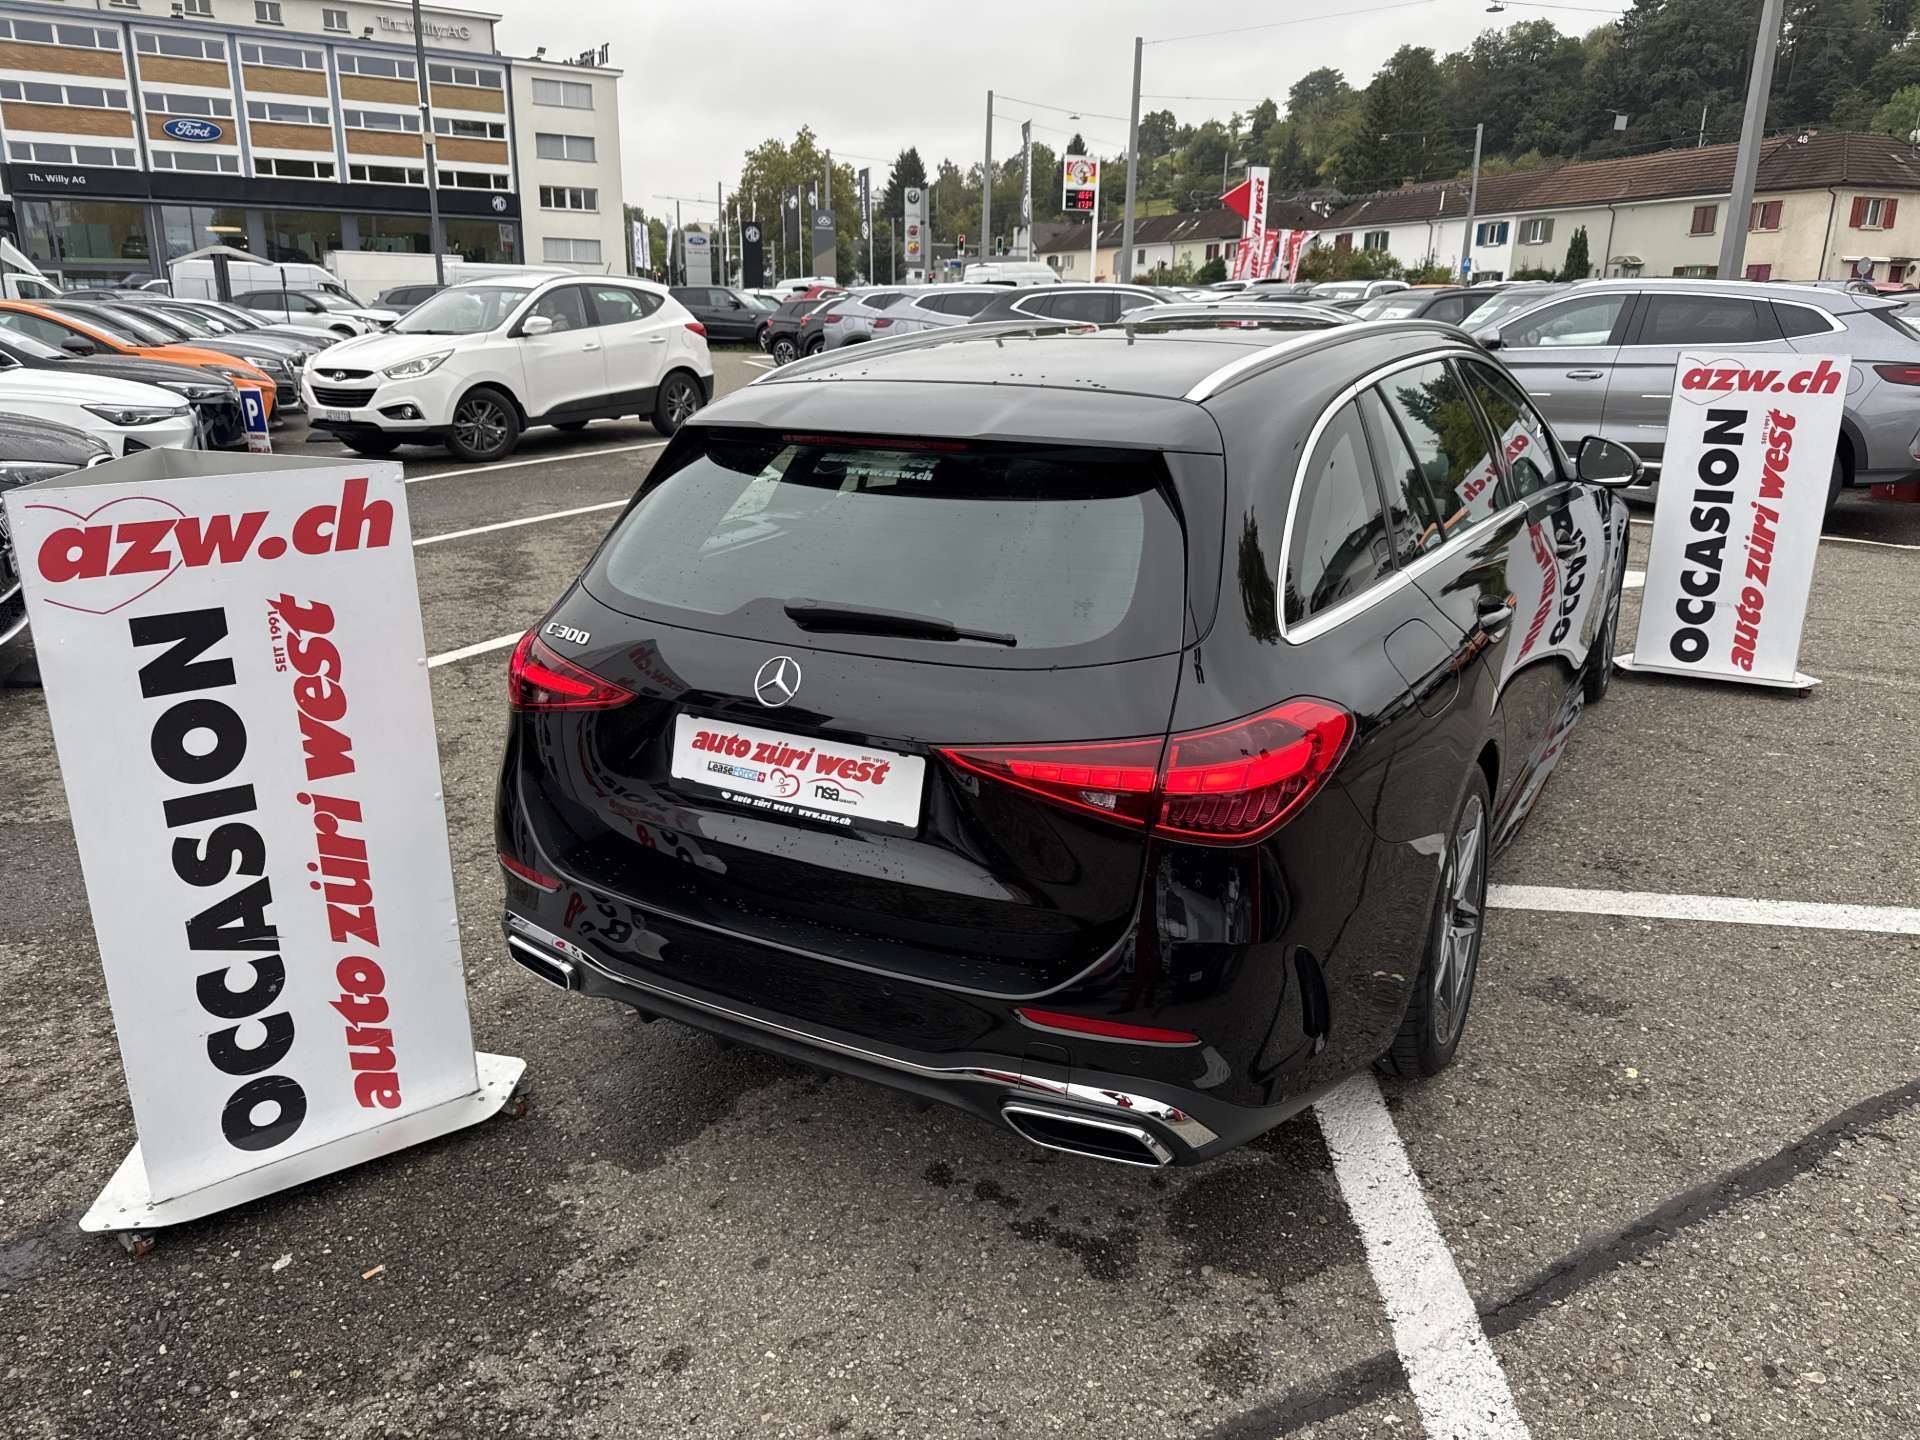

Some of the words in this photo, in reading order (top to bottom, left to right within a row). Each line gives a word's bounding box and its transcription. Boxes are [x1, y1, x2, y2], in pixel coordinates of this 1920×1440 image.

[445, 24, 472, 42] AG
[174, 119, 212, 138] Ford
[1797, 135, 1809, 144] 48
[27, 173, 43, 182] Th.
[45, 174, 69, 185] Willy
[71, 176, 86, 185] AG
[1681, 359, 1842, 394] azw.ch
[245, 398, 259, 427] P
[1759, 408, 1797, 499] west
[846, 466, 935, 481] www.azw.ch
[37, 477, 394, 583] azw.ch
[1669, 408, 1748, 663] OCCASION
[1744, 501, 1780, 588] züri
[268, 609, 283, 639] 1991
[1731, 585, 1764, 672] auto
[273, 645, 288, 673] SEIT
[266, 592, 356, 781] west
[691, 730, 752, 759] auto
[751, 740, 816, 774] züri
[815, 754, 891, 785] west
[707, 760, 758, 782] LeaseForce
[732, 794, 752, 804] auto
[753, 798, 772, 810] züri
[773, 803, 794, 814] west
[798, 808, 852, 826] www.azw.ch
[814, 785, 840, 802] nsa
[127, 606, 308, 1152] OCCASION
[296, 791, 380, 948] züri
[328, 955, 402, 1110] auto
